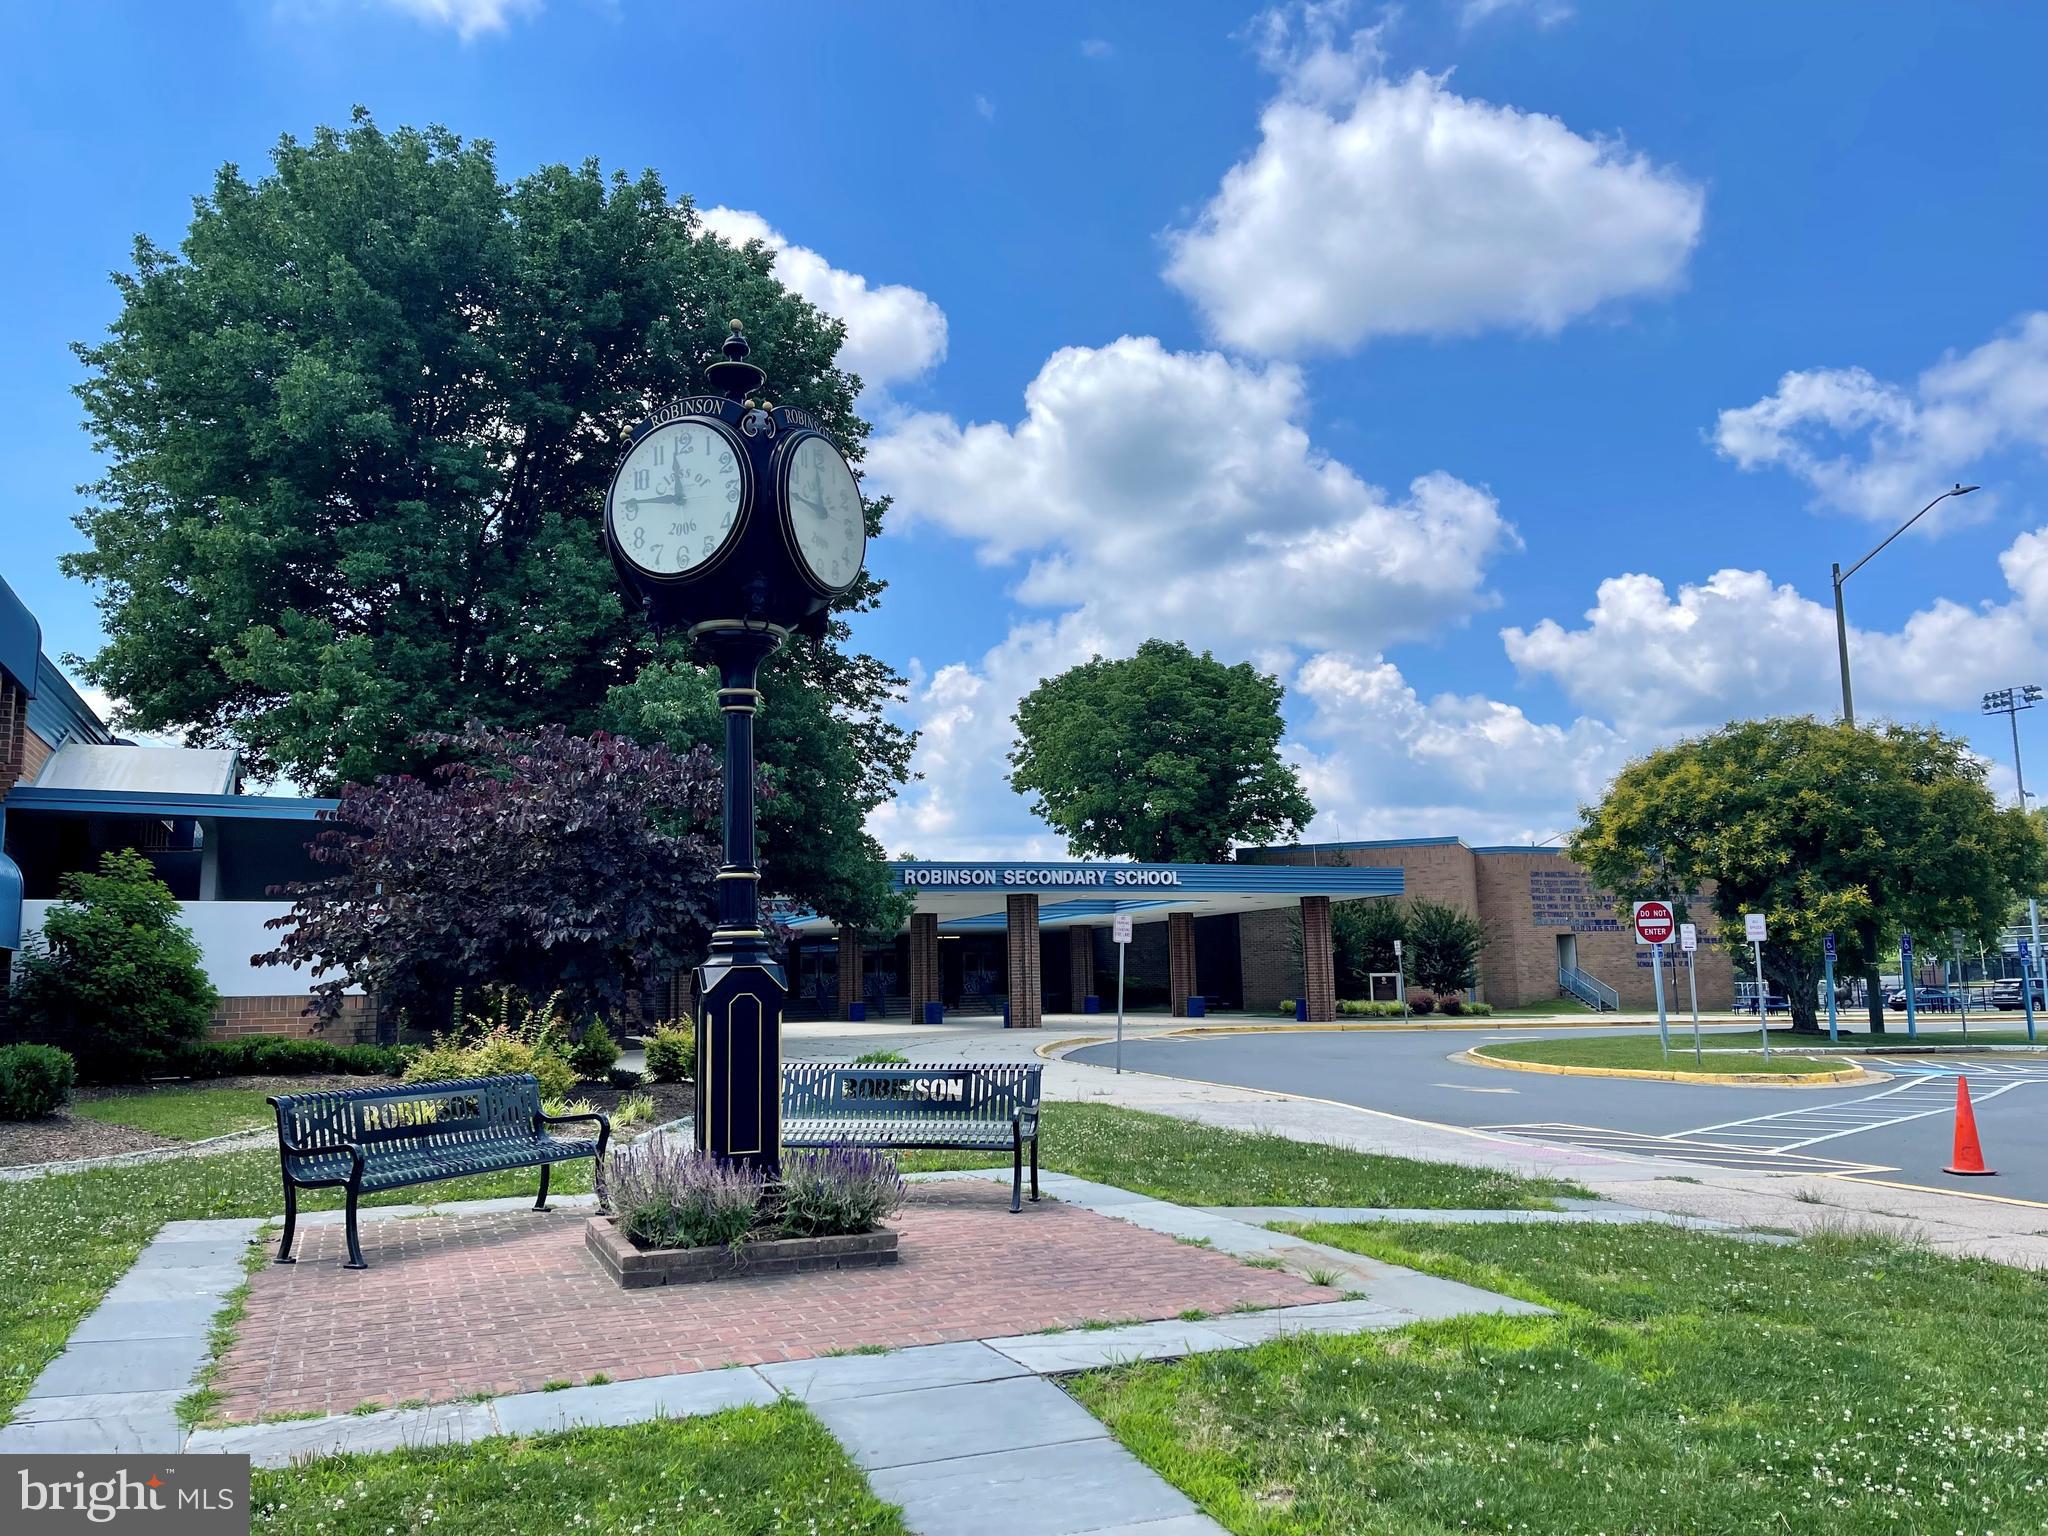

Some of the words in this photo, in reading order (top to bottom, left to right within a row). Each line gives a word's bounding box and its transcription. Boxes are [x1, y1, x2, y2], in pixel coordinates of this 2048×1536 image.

[650, 399, 725, 428] ROBINSON
[674, 432, 694, 455] 12
[719, 451, 735, 473] 2
[633, 527, 645, 549] 8
[668, 519, 697, 536] 2006
[649, 544, 664, 565] 7
[676, 546, 690, 569] 6
[904, 869, 997, 885] ROBINSON
[1003, 869, 1107, 885] SECONDARY
[1114, 870, 1182, 885] SCHOOL
[1644, 928, 1666, 936] ENTER
[841, 1078, 964, 1102] ROBINSON
[363, 1094, 480, 1132] ROBINSON
